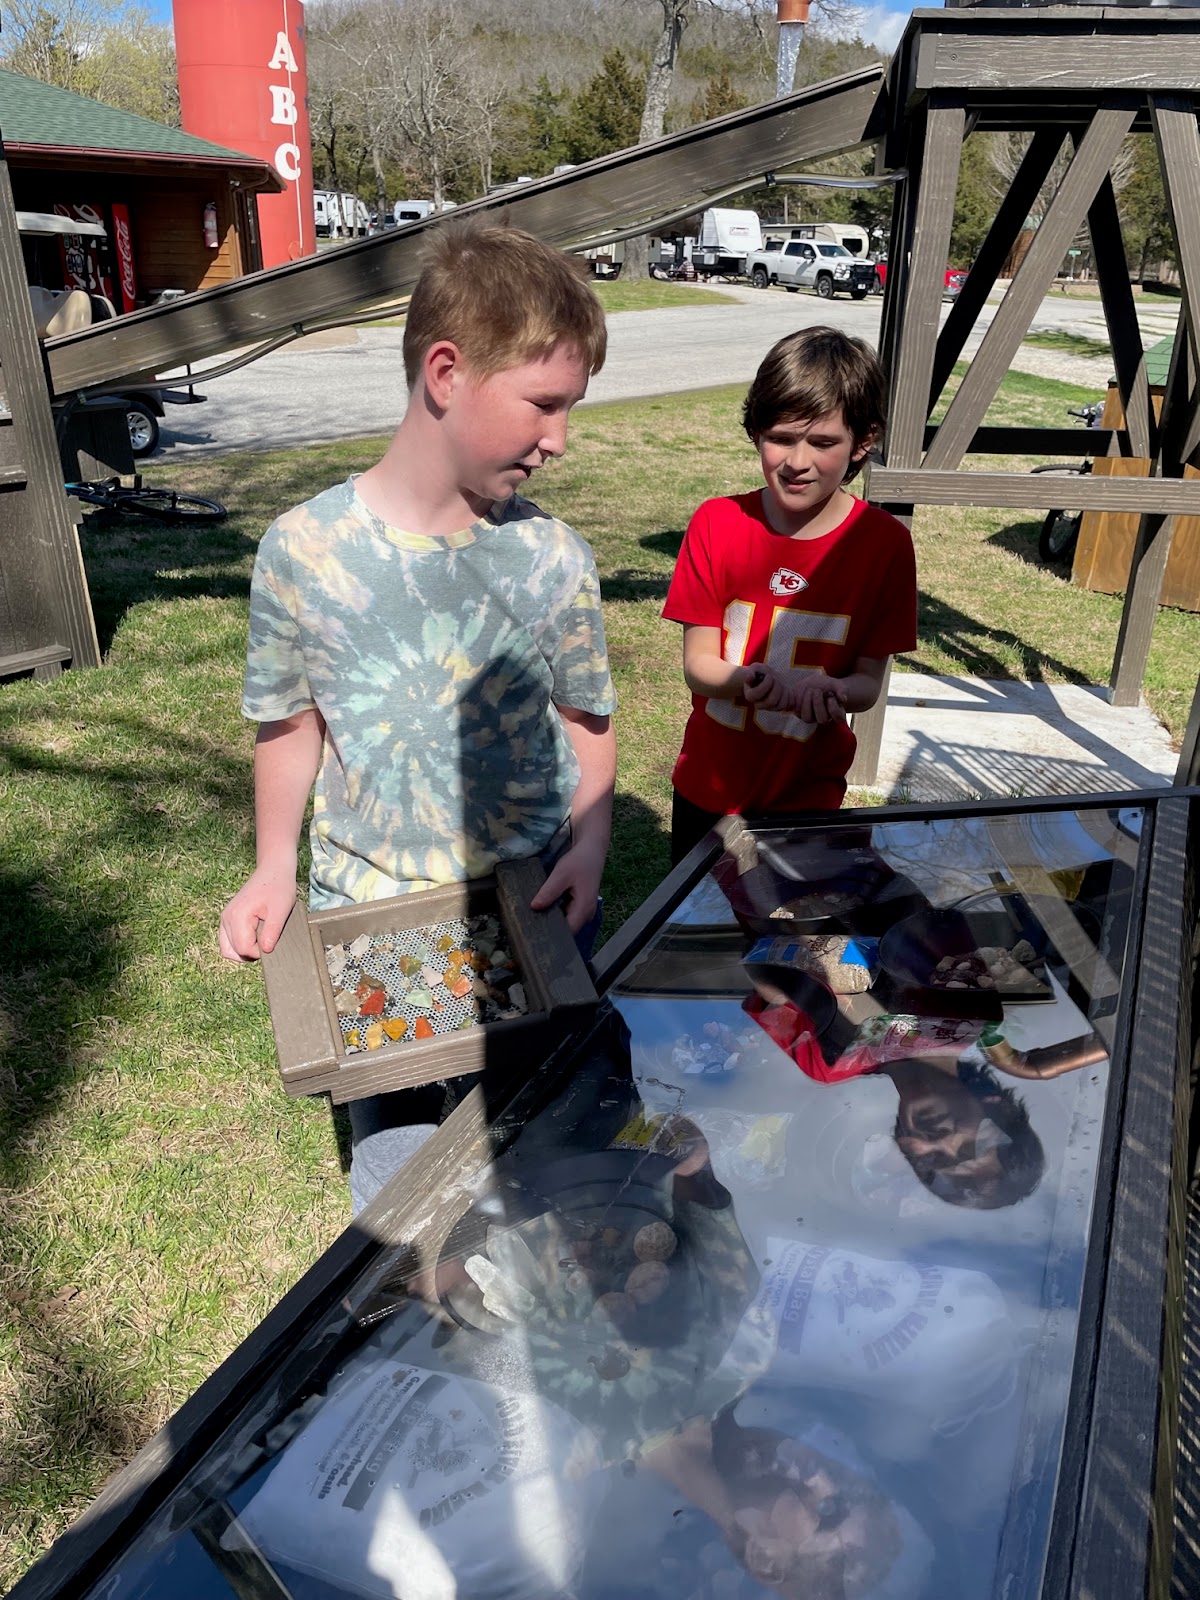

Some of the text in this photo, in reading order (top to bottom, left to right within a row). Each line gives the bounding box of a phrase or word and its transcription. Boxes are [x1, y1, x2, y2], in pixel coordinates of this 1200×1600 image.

[268, 31, 301, 181] ABC
[779, 575, 800, 590] KC
[705, 599, 851, 742] 15
[782, 1287, 809, 1322] Bag
